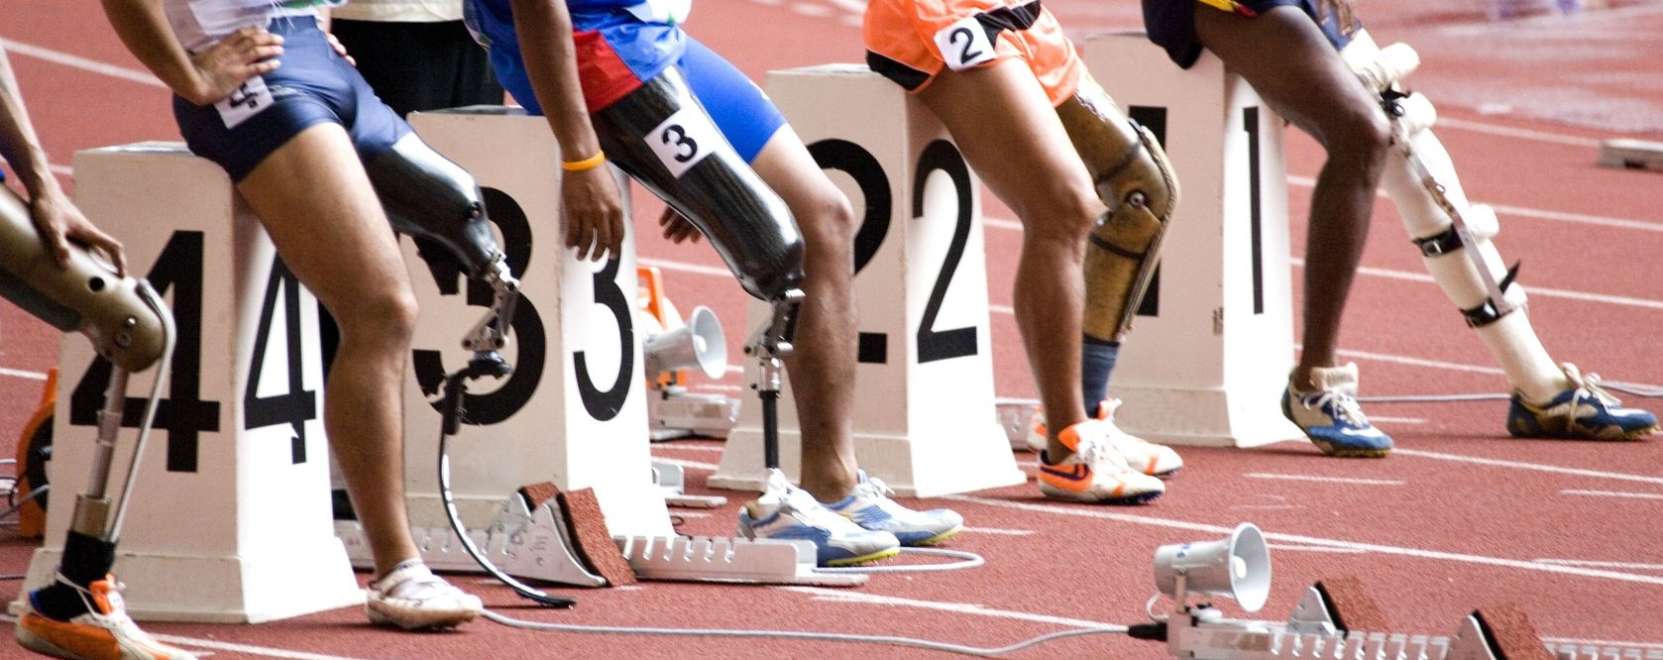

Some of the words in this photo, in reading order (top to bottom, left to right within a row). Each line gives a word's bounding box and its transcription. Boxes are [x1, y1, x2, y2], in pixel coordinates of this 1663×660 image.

[662, 124, 698, 163] 3
[949, 27, 983, 64] 2
[412, 186, 546, 425] 3
[913, 138, 978, 364] 2
[1243, 106, 1264, 315] 1
[70, 230, 220, 473] 4
[244, 250, 317, 464] 4
